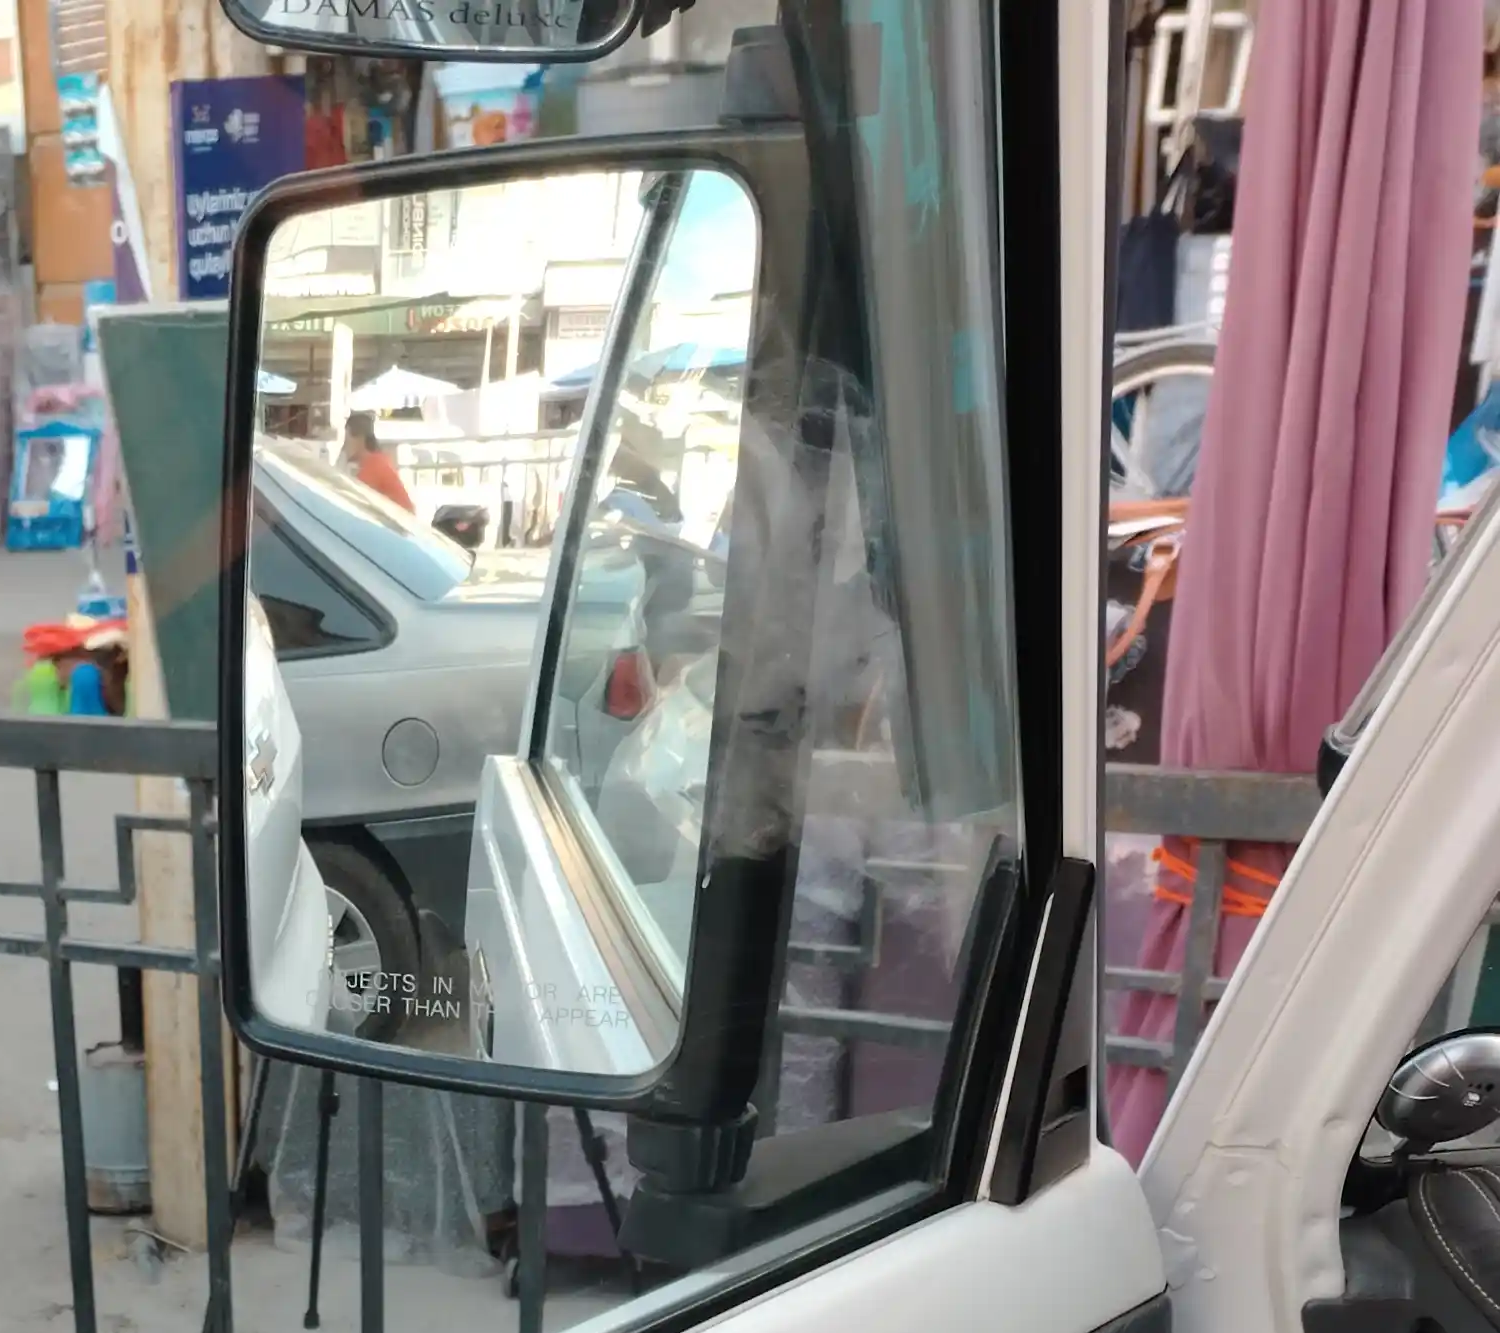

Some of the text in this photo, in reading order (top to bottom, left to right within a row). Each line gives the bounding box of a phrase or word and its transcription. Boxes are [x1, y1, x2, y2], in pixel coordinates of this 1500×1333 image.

[281, 0, 434, 22] DAMAS
[320, 967, 622, 1004] JECTS IN MOR ARE
[401, 997, 461, 1019] THAN
[539, 1007, 630, 1028] APPEAR
